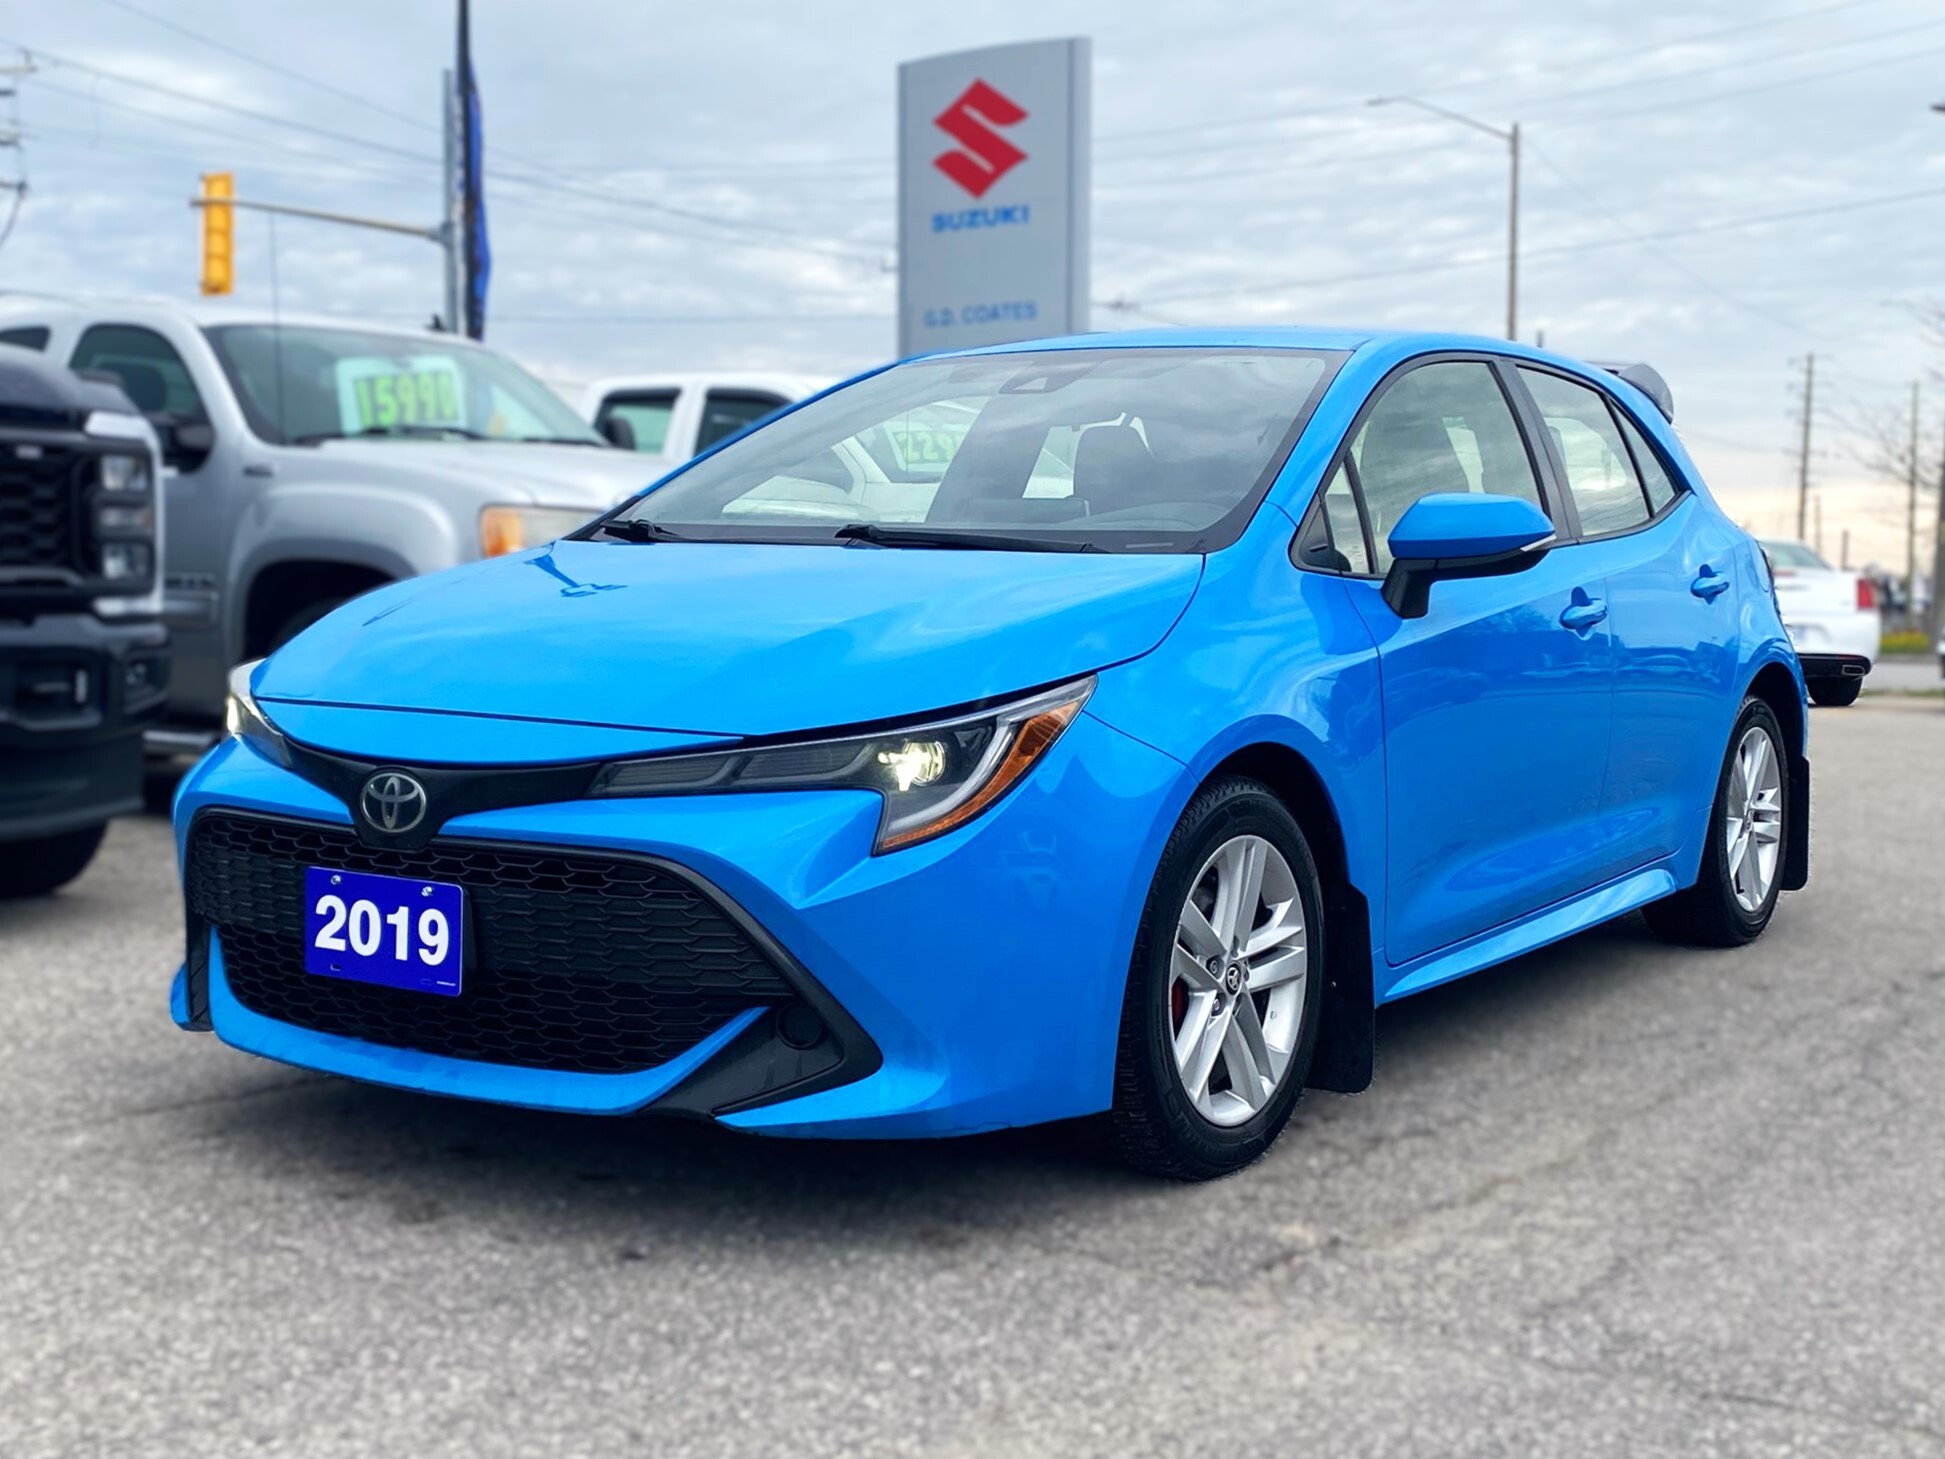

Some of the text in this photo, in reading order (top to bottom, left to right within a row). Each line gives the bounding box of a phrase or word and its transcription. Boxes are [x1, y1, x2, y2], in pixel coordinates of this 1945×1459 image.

[931, 204, 1030, 232] SUZUKI
[961, 301, 1038, 325] COATES
[315, 895, 449, 966] 2019
